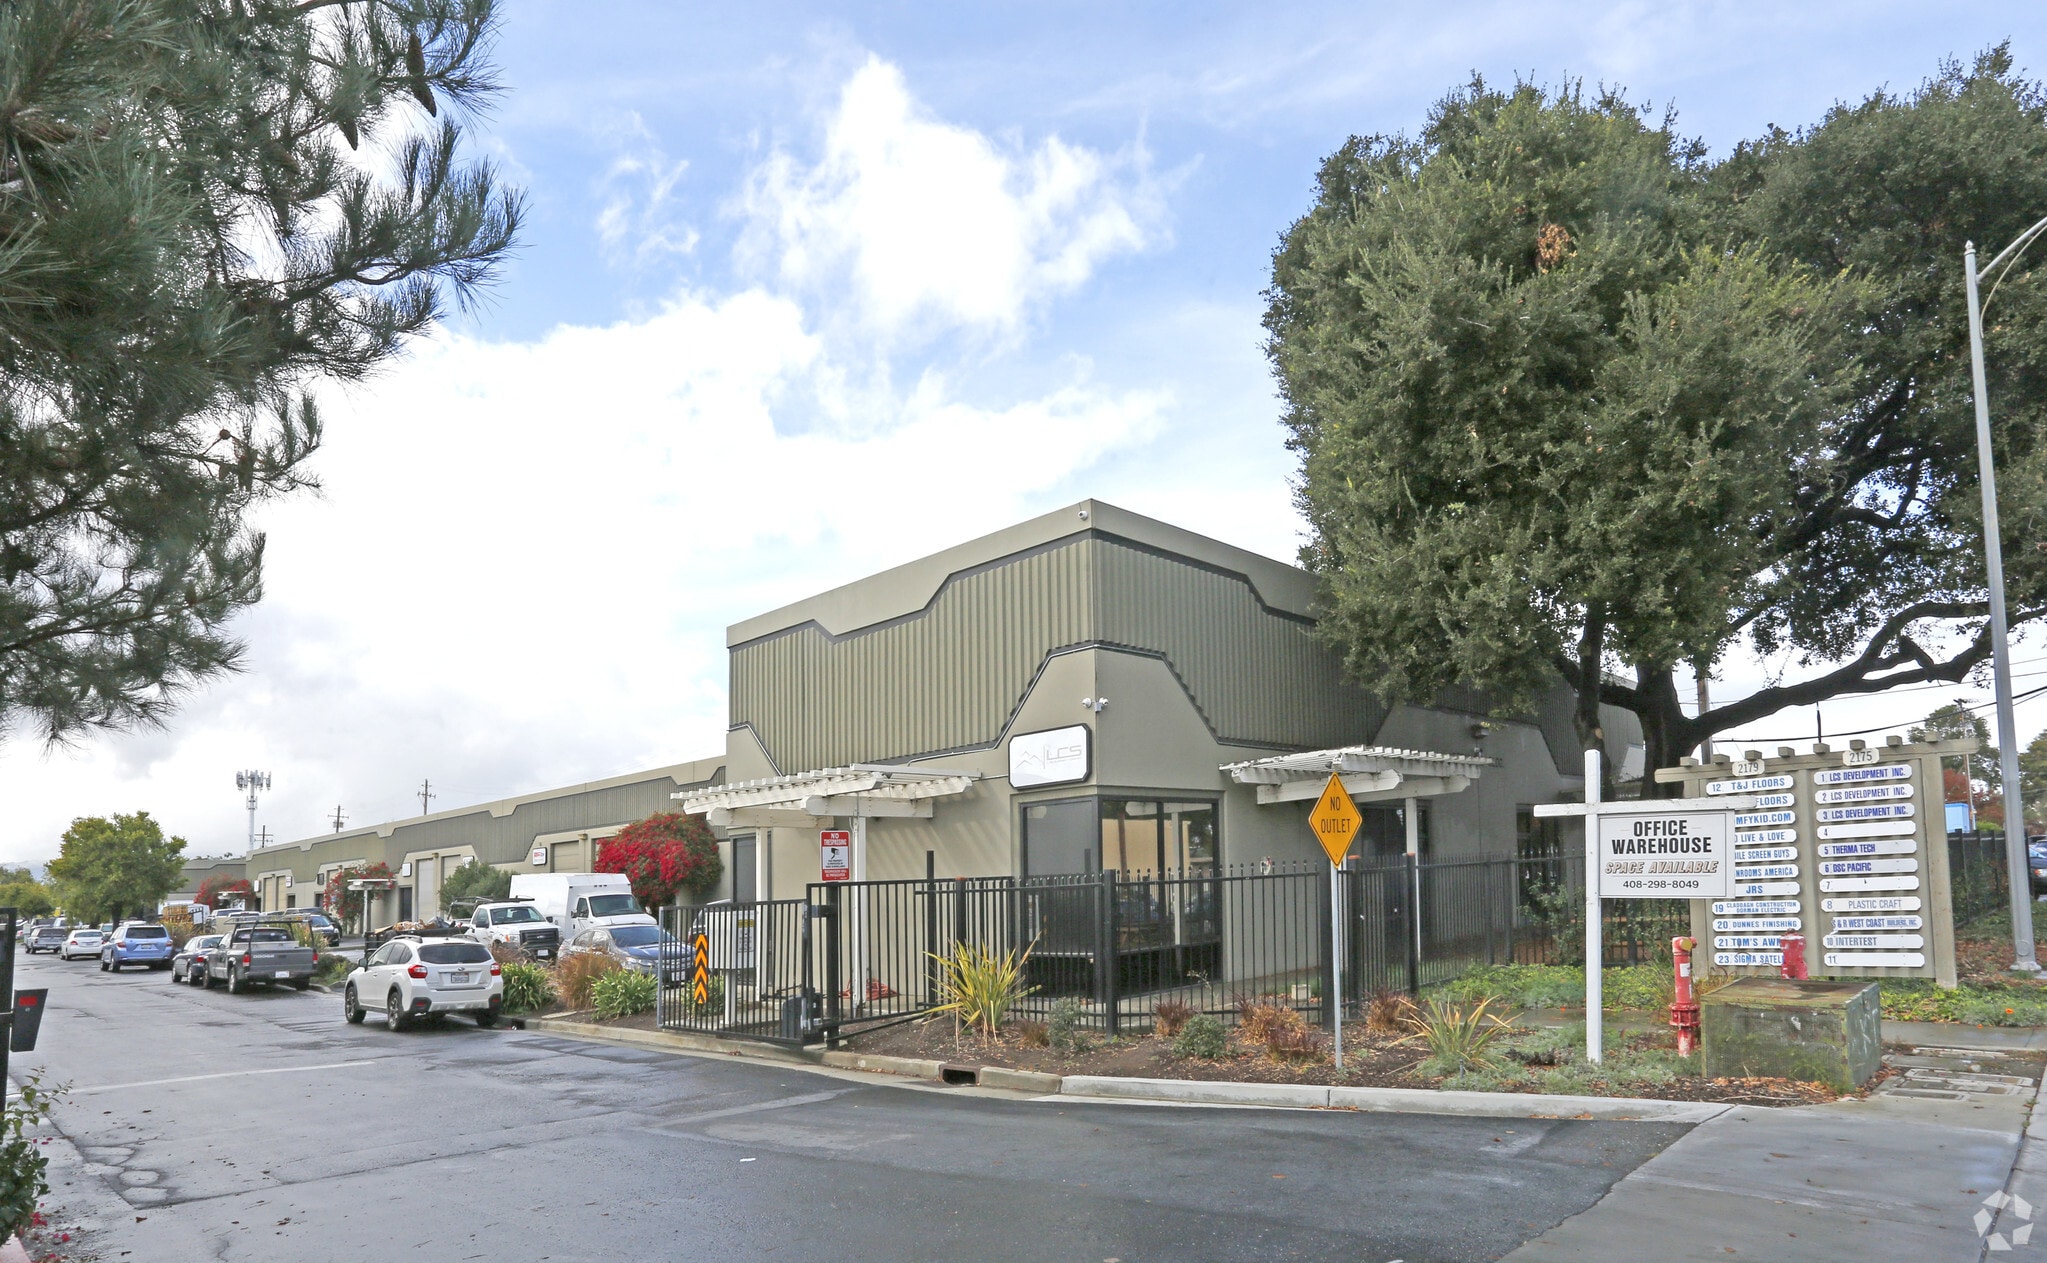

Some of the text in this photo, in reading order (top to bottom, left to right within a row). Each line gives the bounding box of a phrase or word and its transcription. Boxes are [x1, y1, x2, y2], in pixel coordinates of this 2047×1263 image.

[1046, 744, 1082, 761] LCS
[1849, 751, 1873, 763] 2175
[1738, 762, 1759, 774] 2179
[1821, 767, 1906, 782] 1 LCS DEVELOPMENT INC.
[1712, 778, 1785, 792] 12 T&J FLOORS
[1822, 786, 1907, 801] 2 LCS DEVELOPMENT INC.
[1330, 796, 1341, 811] NO
[1823, 805, 1908, 820] 3 LCS DEVELOPMENT INC.
[1320, 818, 1351, 833] OUTLET
[1633, 819, 1688, 837] OFFICE
[1741, 833, 1756, 842] LIVE
[1759, 832, 1764, 841] &
[1767, 831, 1785, 841] LOVE
[1823, 828, 1828, 837] 4
[1611, 836, 1712, 855] WAREHOUSE
[1824, 843, 1876, 855] 5 THERMA TECH
[1748, 850, 1771, 859] SCREEN
[1773, 849, 1790, 858] GUYS
[1605, 860, 1719, 874] SPACE AVAILABLE
[1764, 867, 1793, 876] AMERICA
[1824, 864, 1829, 873] 6
[1846, 862, 1872, 872] PACIFIC
[1622, 880, 1700, 889] 408-298-8049
[1745, 885, 1764, 894] JRS
[1826, 881, 1831, 890] 7
[1715, 904, 1724, 913] 19
[1826, 899, 1902, 909] 8 PLASTIC CRAFT
[1717, 920, 1798, 929] 20 DUNNES FINISHING
[1843, 919, 1848, 928] R
[1848, 918, 1865, 928] WEST
[1866, 918, 1885, 928] COAST
[1718, 938, 1729, 947] 21
[1732, 938, 1759, 947] TOM'S
[1826, 936, 1877, 946] 10 INTERTEST
[1718, 955, 1730, 964] 23
[1734, 954, 1757, 964] SIGMA
[1828, 955, 1836, 964] 11
